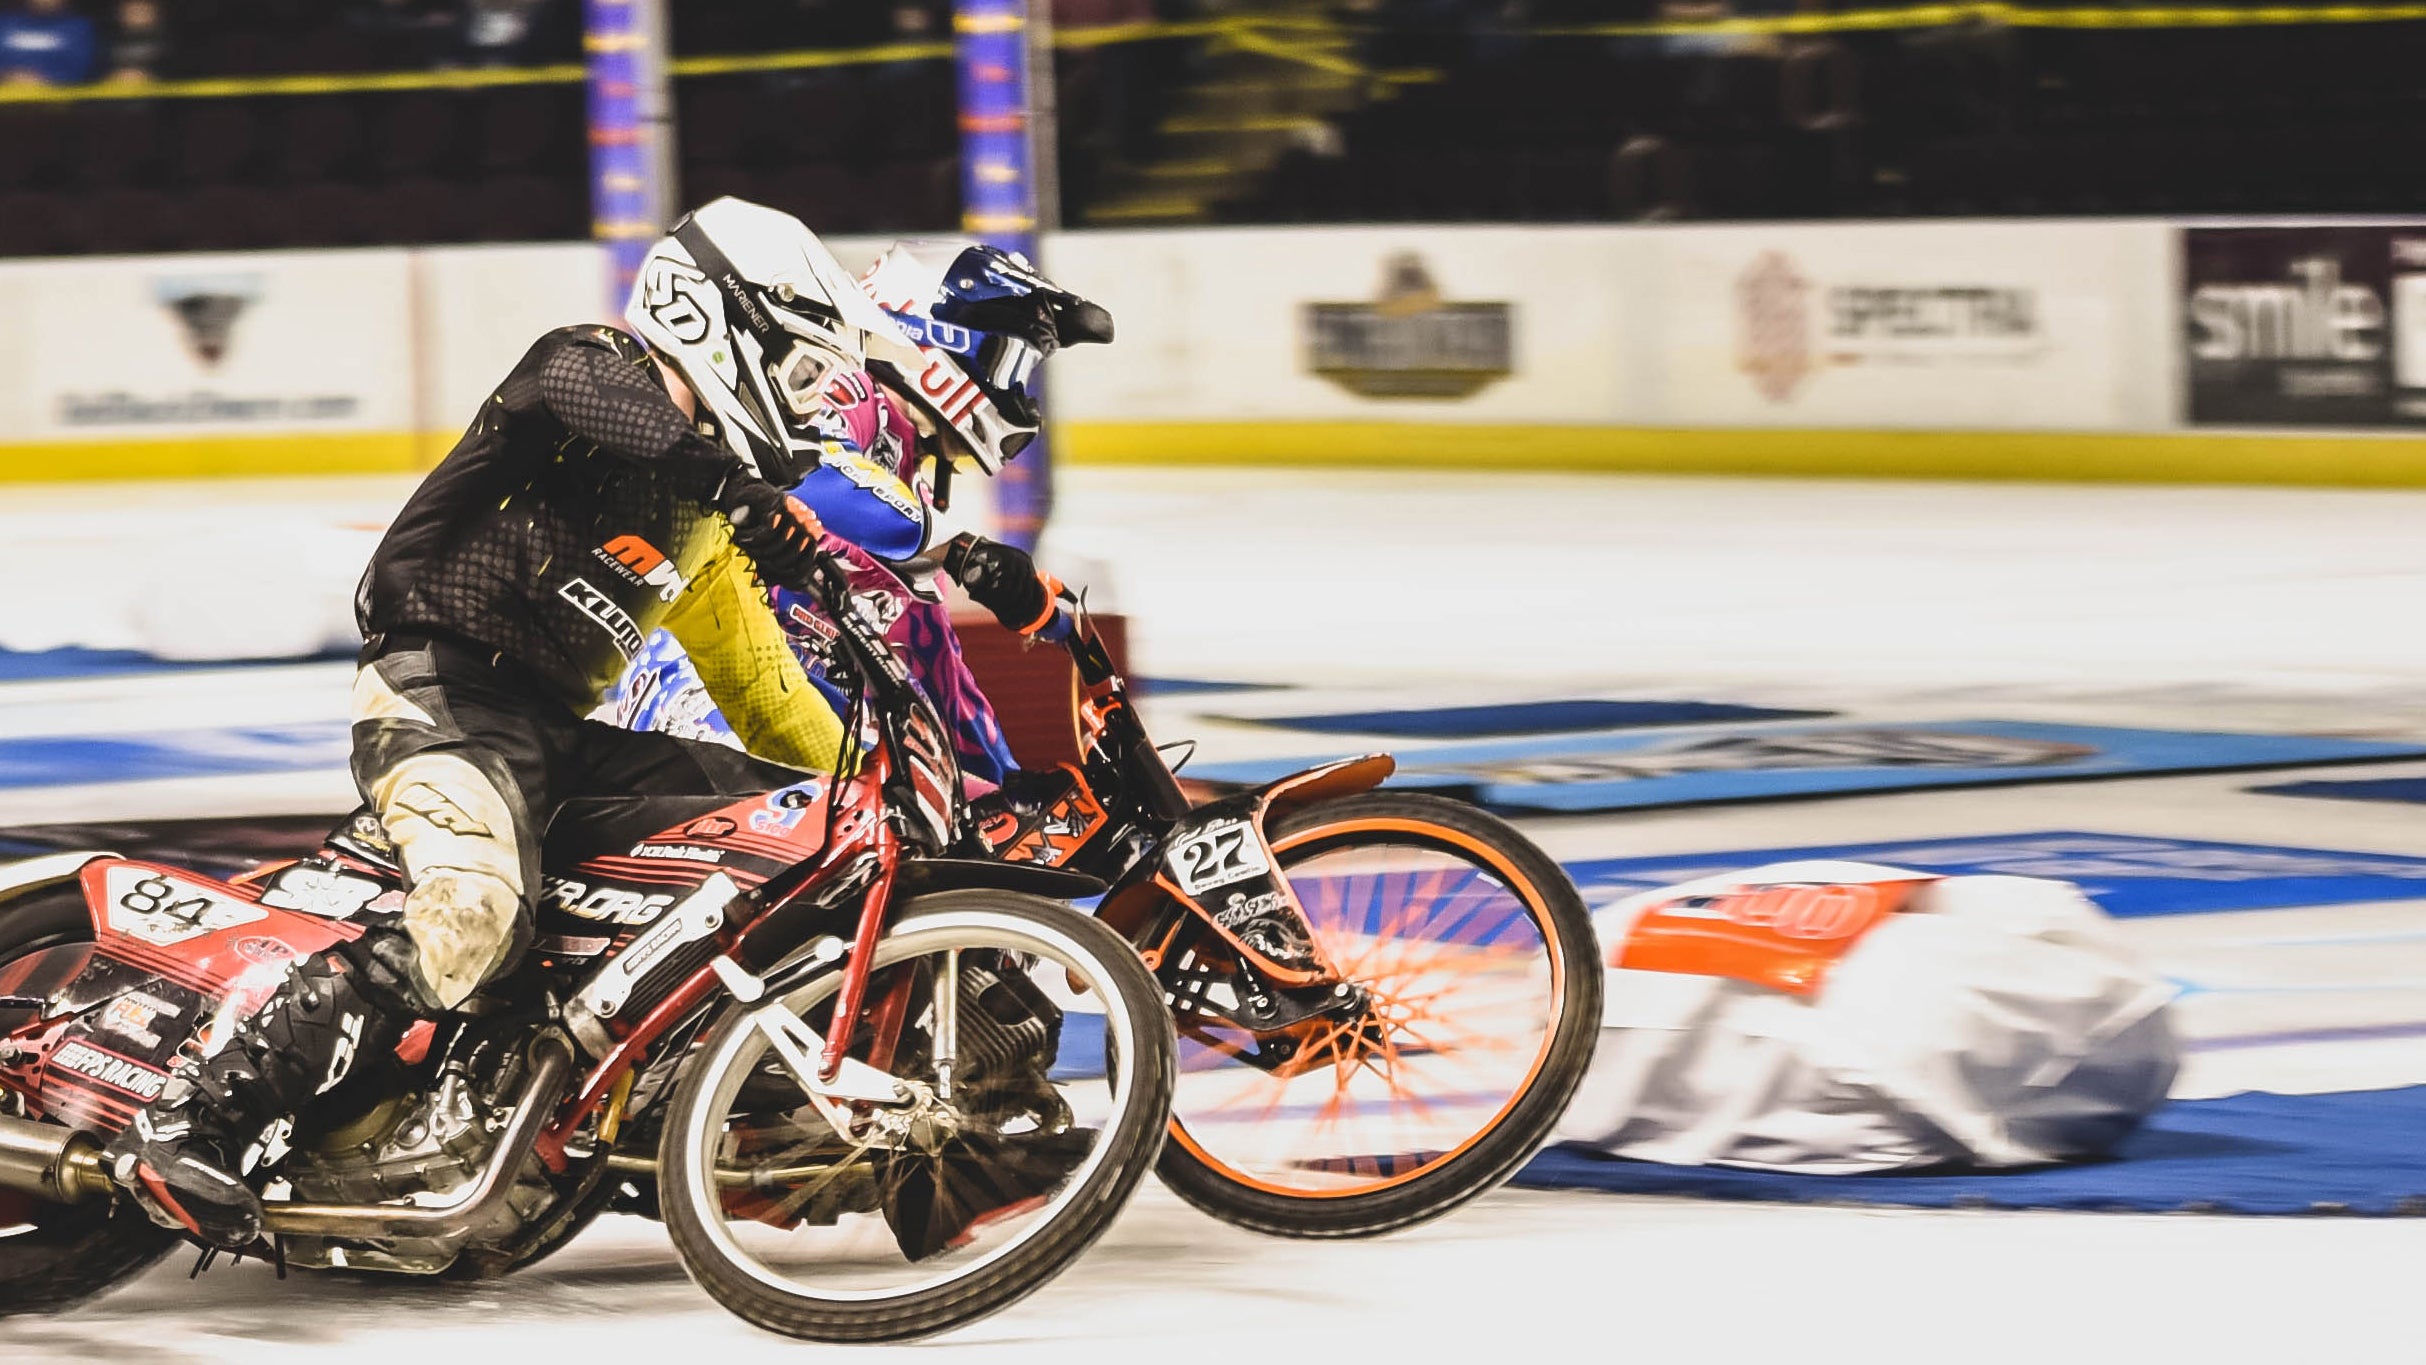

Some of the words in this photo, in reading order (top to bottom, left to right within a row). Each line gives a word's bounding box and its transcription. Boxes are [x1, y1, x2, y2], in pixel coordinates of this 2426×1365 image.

[723, 273, 769, 332] MARIENER
[2192, 258, 2384, 359] smile
[921, 361, 985, 427] ull
[591, 547, 644, 587] RACEWEAR
[1183, 828, 1247, 882] 27
[120, 879, 212, 926] 84
[100, 1060, 167, 1098] RACING
